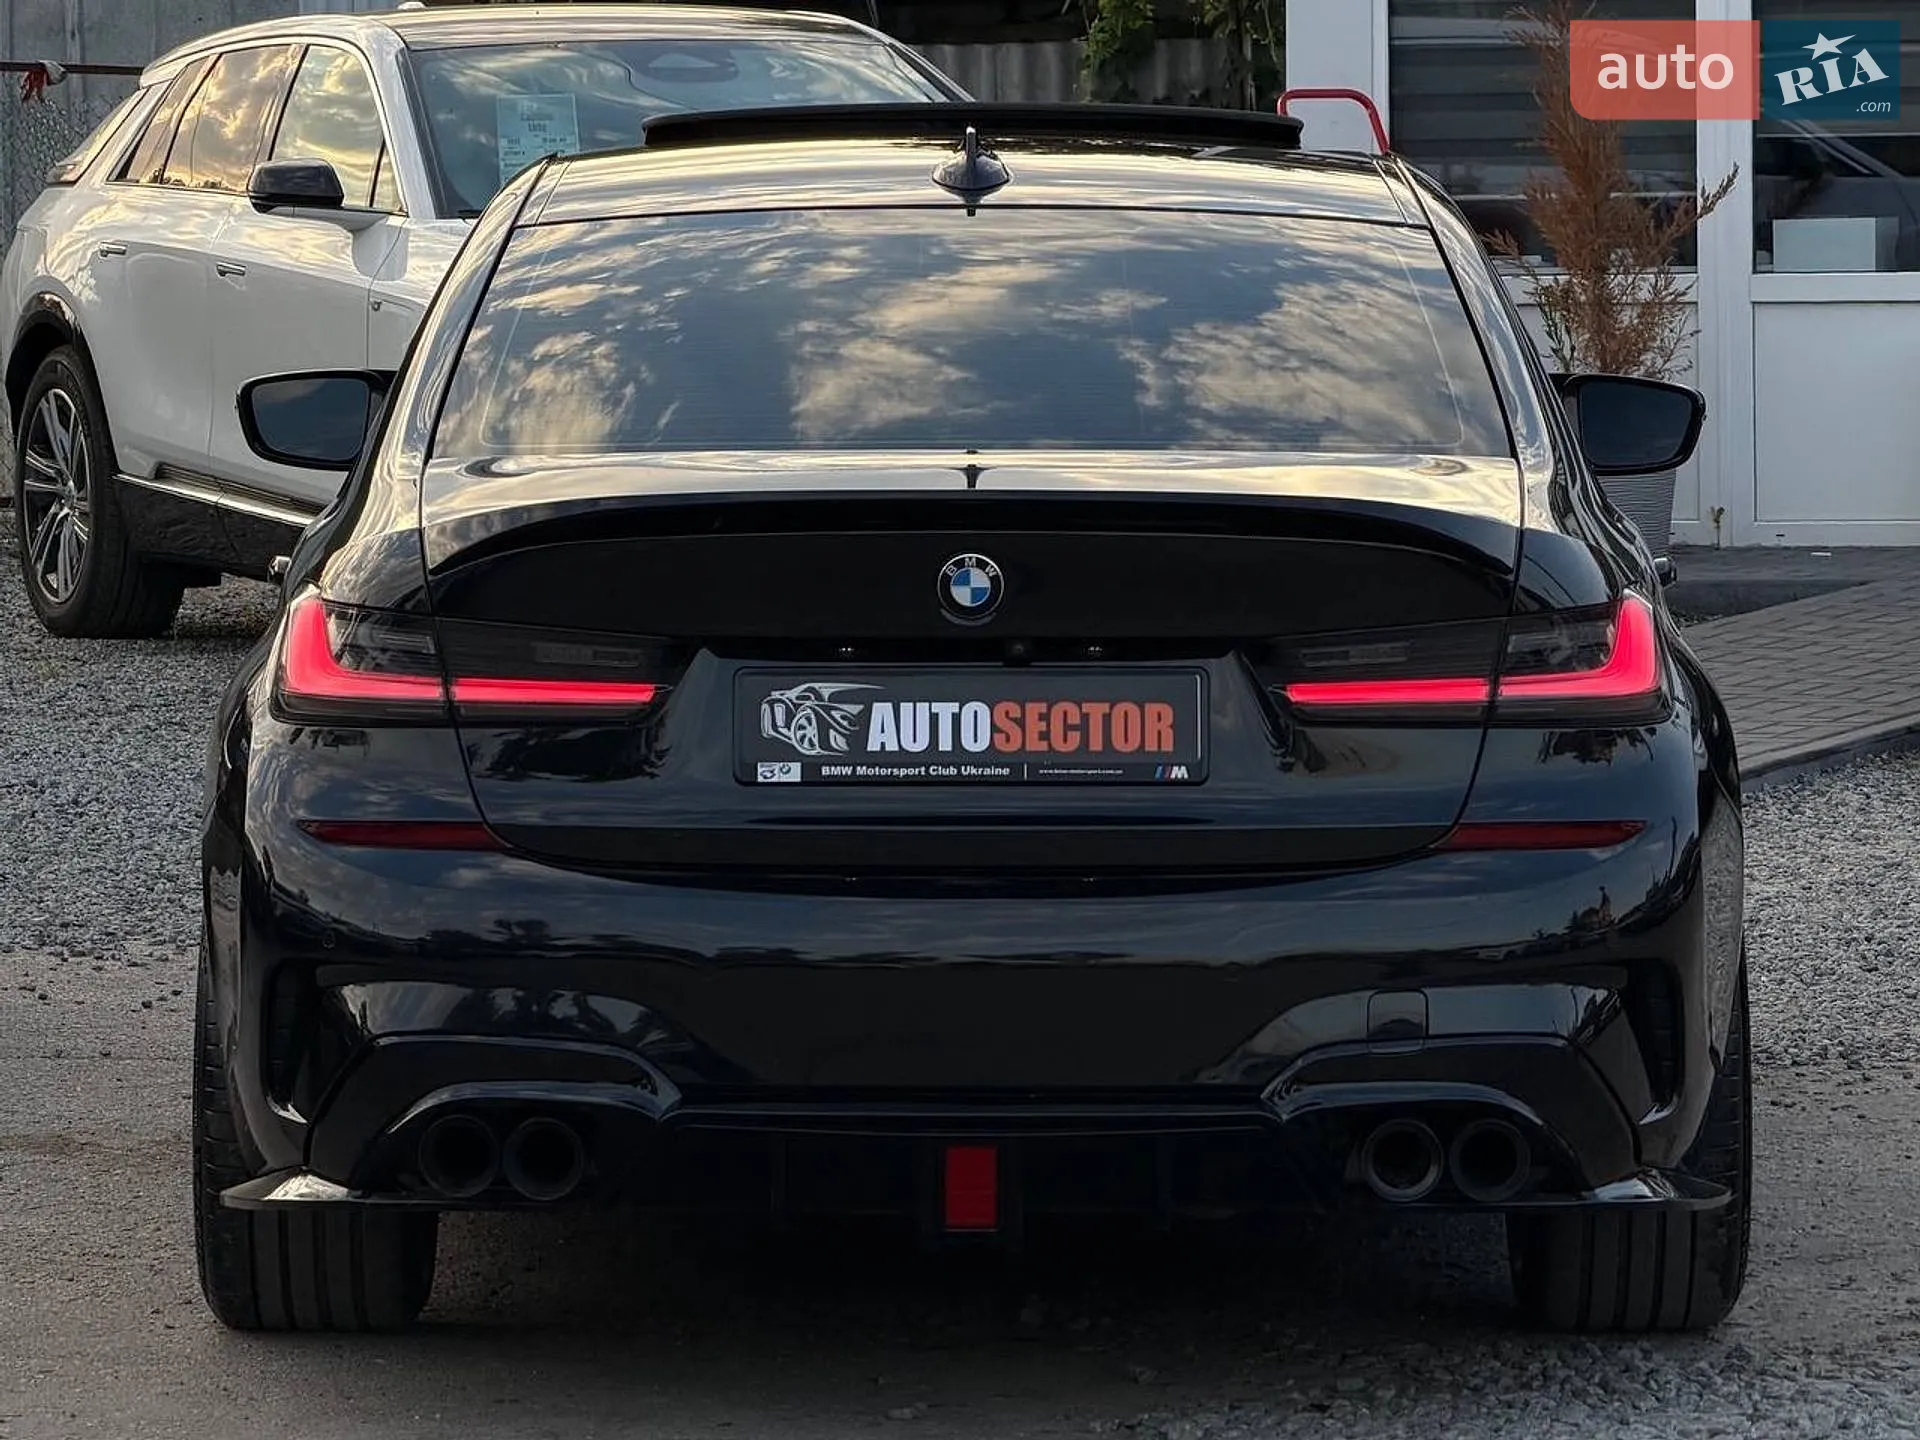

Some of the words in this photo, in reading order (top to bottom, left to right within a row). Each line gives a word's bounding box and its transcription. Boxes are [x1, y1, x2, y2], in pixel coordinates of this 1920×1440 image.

[946, 557, 997, 577] BMW
[867, 701, 1174, 753] AUTOSECTOR
[821, 766, 852, 776] BMW
[856, 765, 925, 778] Motorsport
[929, 765, 957, 776] Club
[961, 765, 1010, 776] Ukraine
